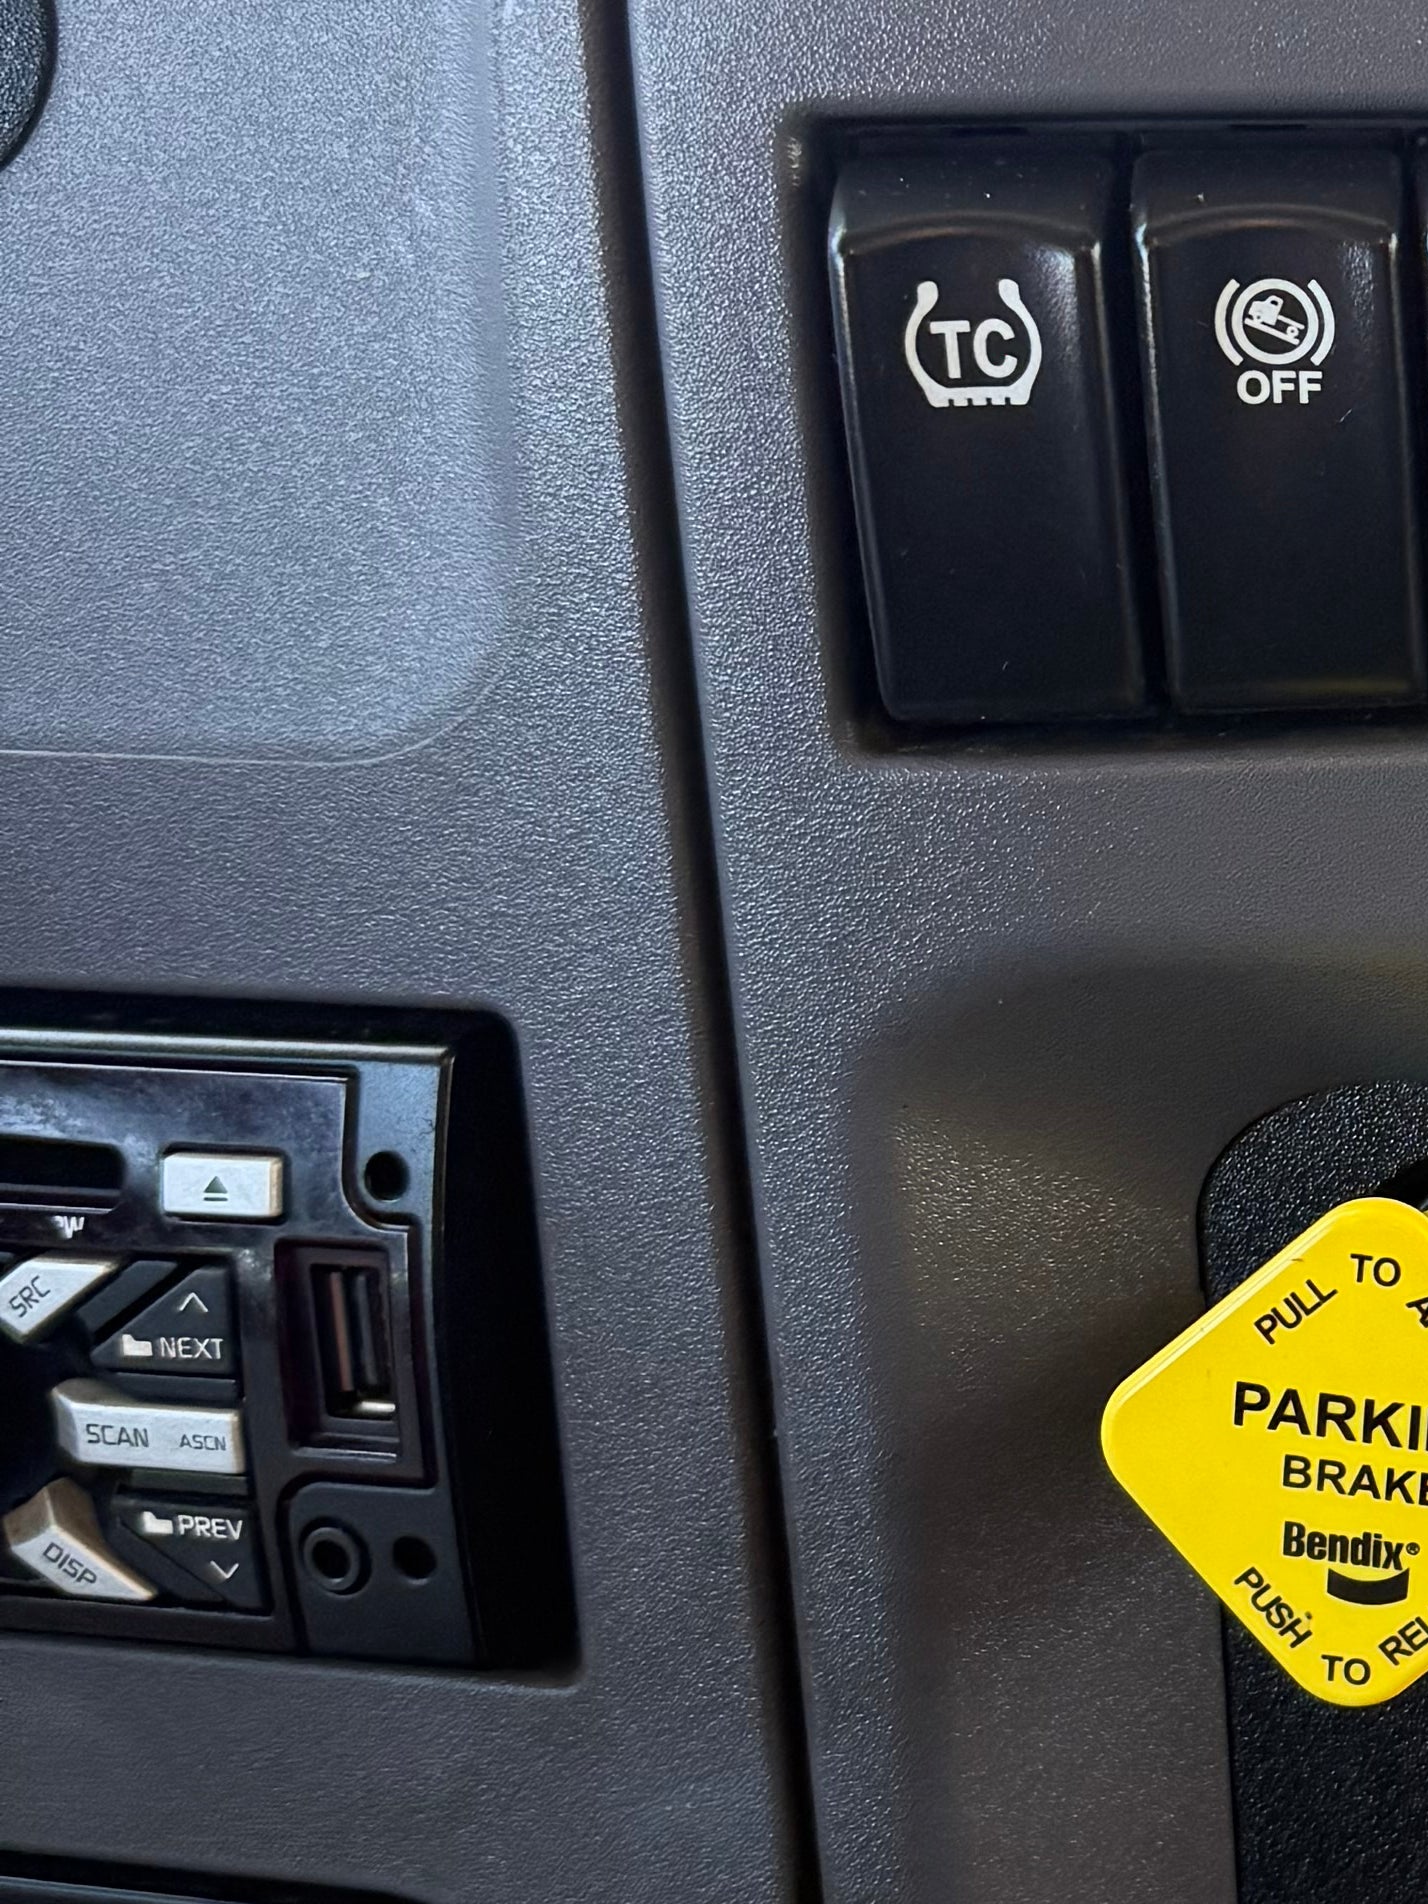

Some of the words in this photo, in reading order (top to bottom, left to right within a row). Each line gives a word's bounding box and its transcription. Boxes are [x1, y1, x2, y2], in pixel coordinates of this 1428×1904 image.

[929, 320, 1018, 380] TC
[1236, 370, 1323, 405] OFF
[9, 1275, 51, 1318] SRC
[1253, 1278, 1338, 1345] PULL
[1350, 1252, 1401, 1288] TO
[159, 1336, 224, 1360] NEXT
[86, 1423, 149, 1447] SCAN
[179, 1433, 227, 1451] ASCN
[177, 1514, 243, 1540] PREV
[43, 1542, 98, 1584] DISP
[1233, 1565, 1314, 1650] PUSH
[1320, 1654, 1371, 1686] TO
